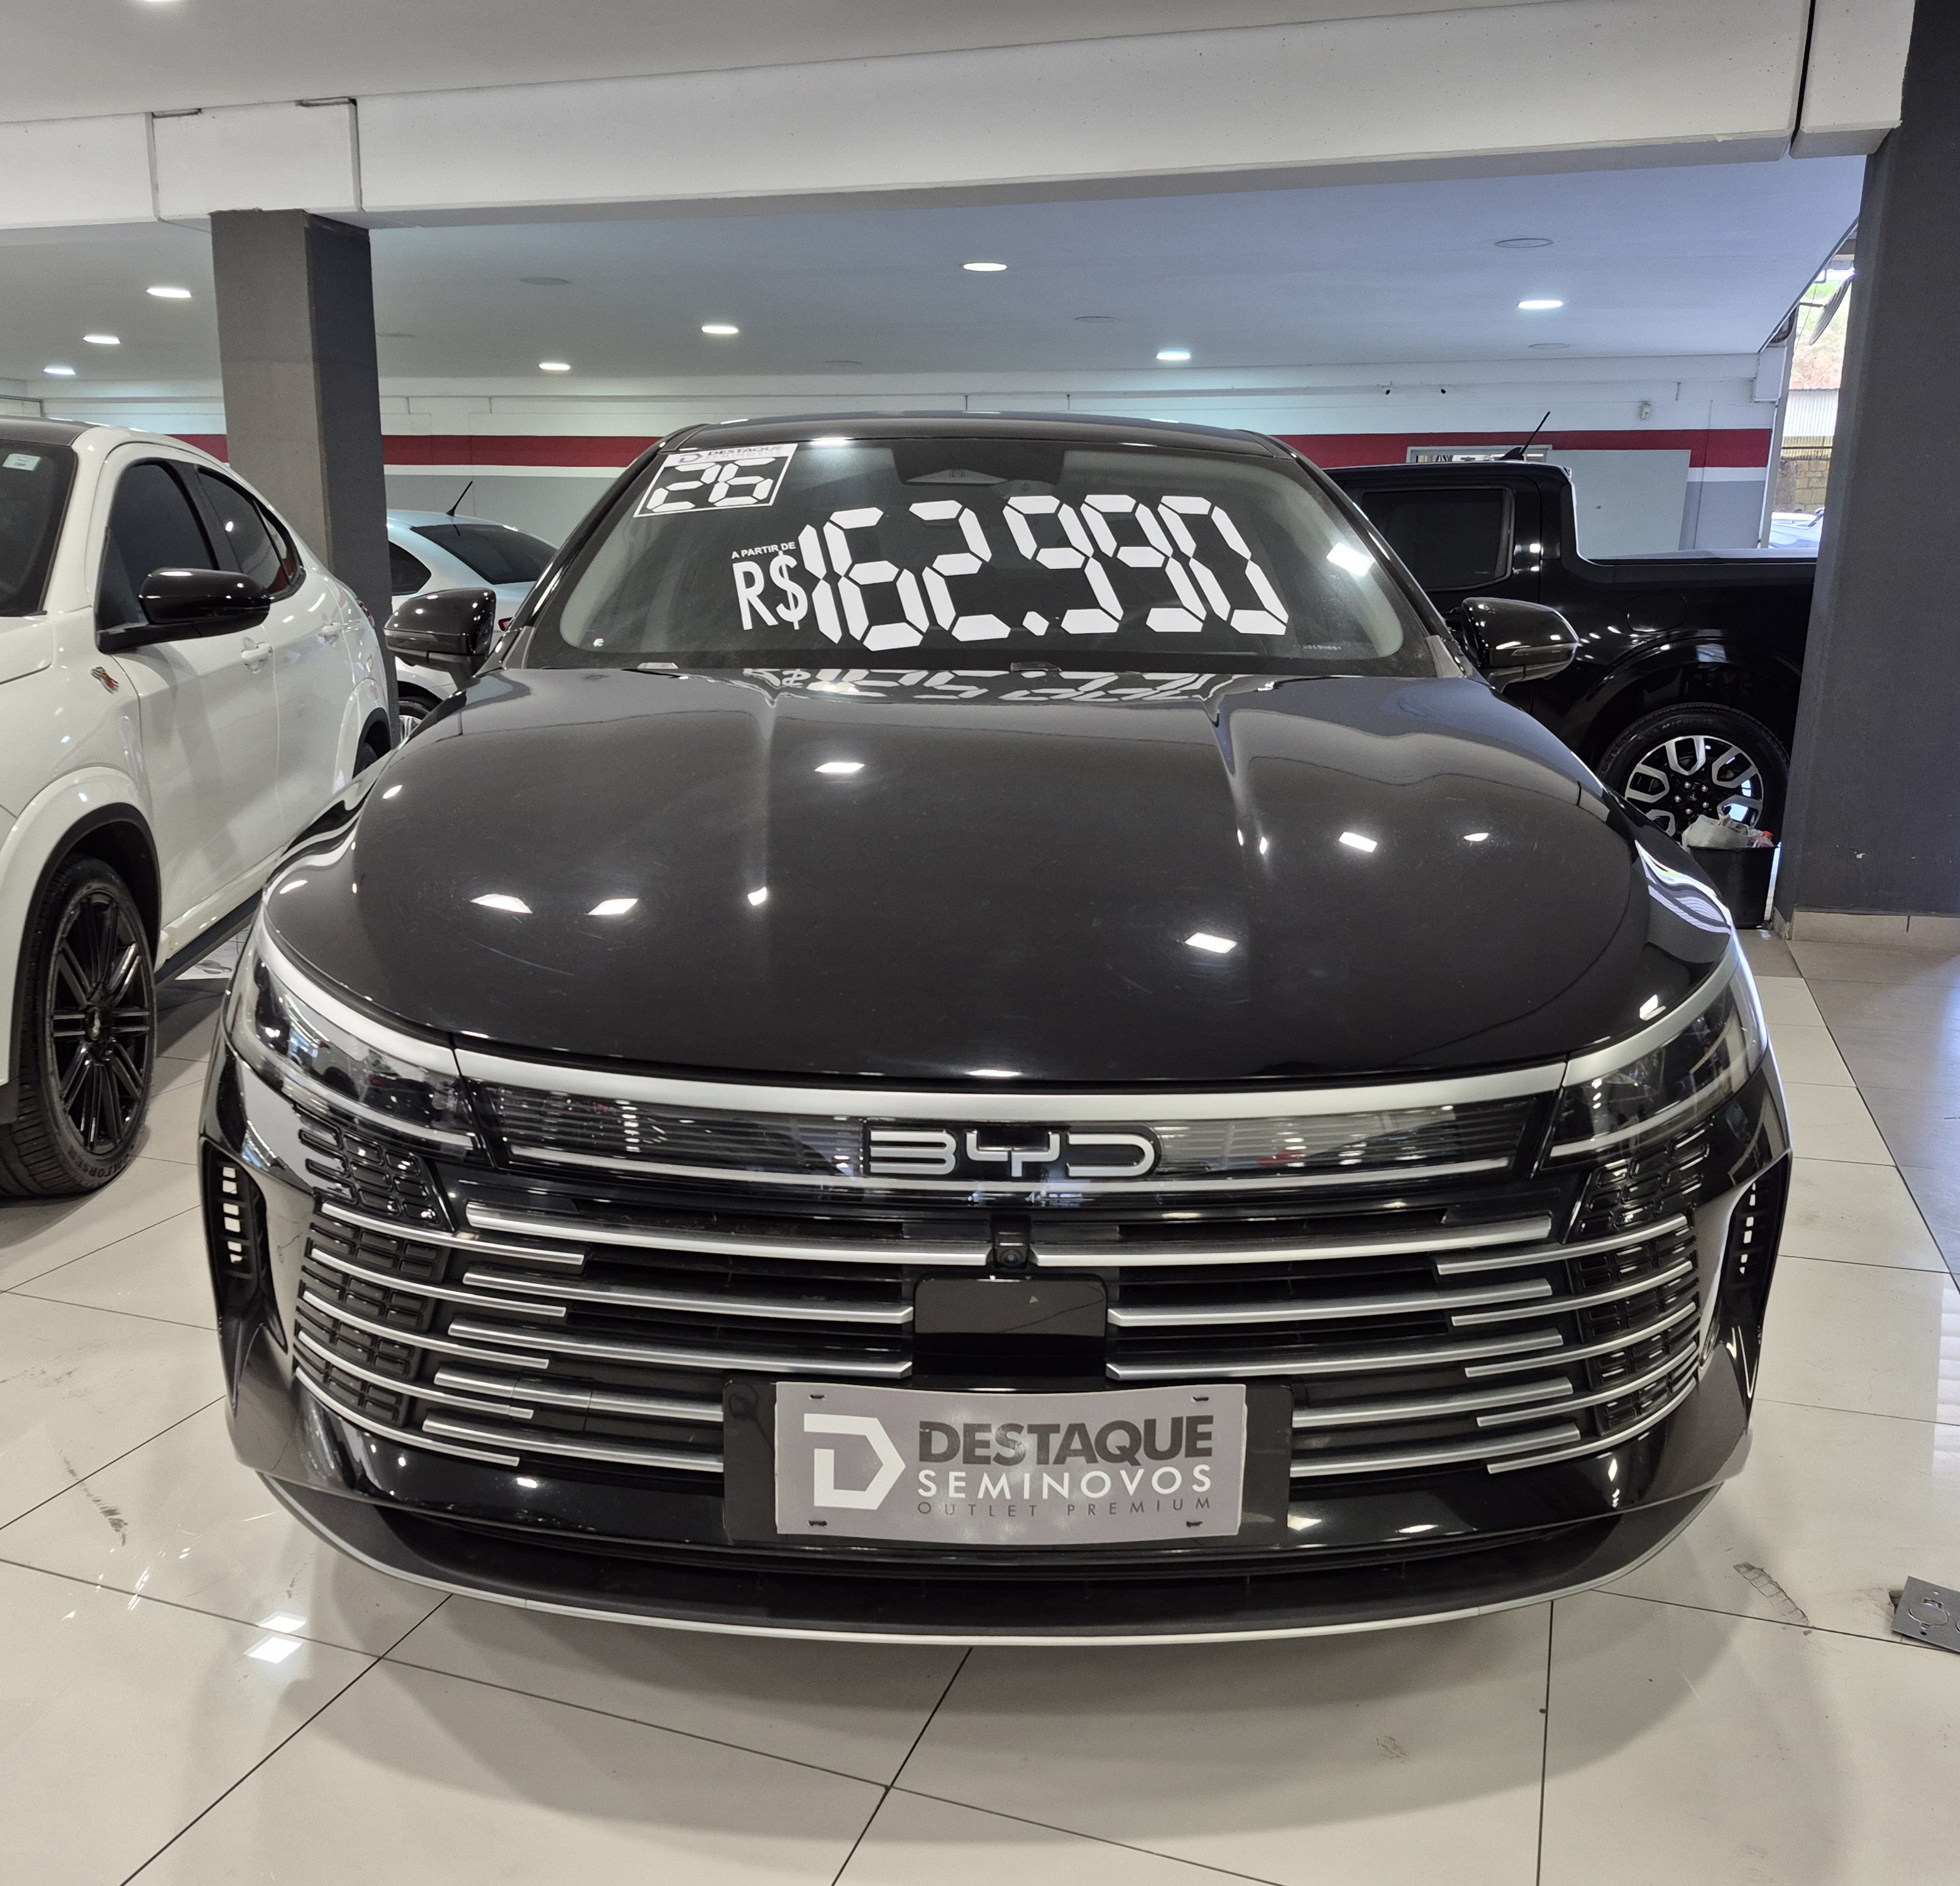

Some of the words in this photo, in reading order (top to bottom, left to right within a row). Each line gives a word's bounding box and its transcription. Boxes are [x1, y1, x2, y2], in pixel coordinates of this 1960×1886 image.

[708, 445, 784, 456] DESTAQUE
[646, 457, 776, 513] 26
[731, 551, 740, 560] A
[741, 544, 779, 558] PARTIR
[780, 541, 796, 551] DE
[869, 1130, 1155, 1177] BYD
[918, 1414, 1214, 1467] DESTAQUE
[917, 1464, 1212, 1500] SEMINOVOS
[917, 1501, 1037, 1518] OUTLET
[1067, 1497, 1211, 1516] PREMIUM
